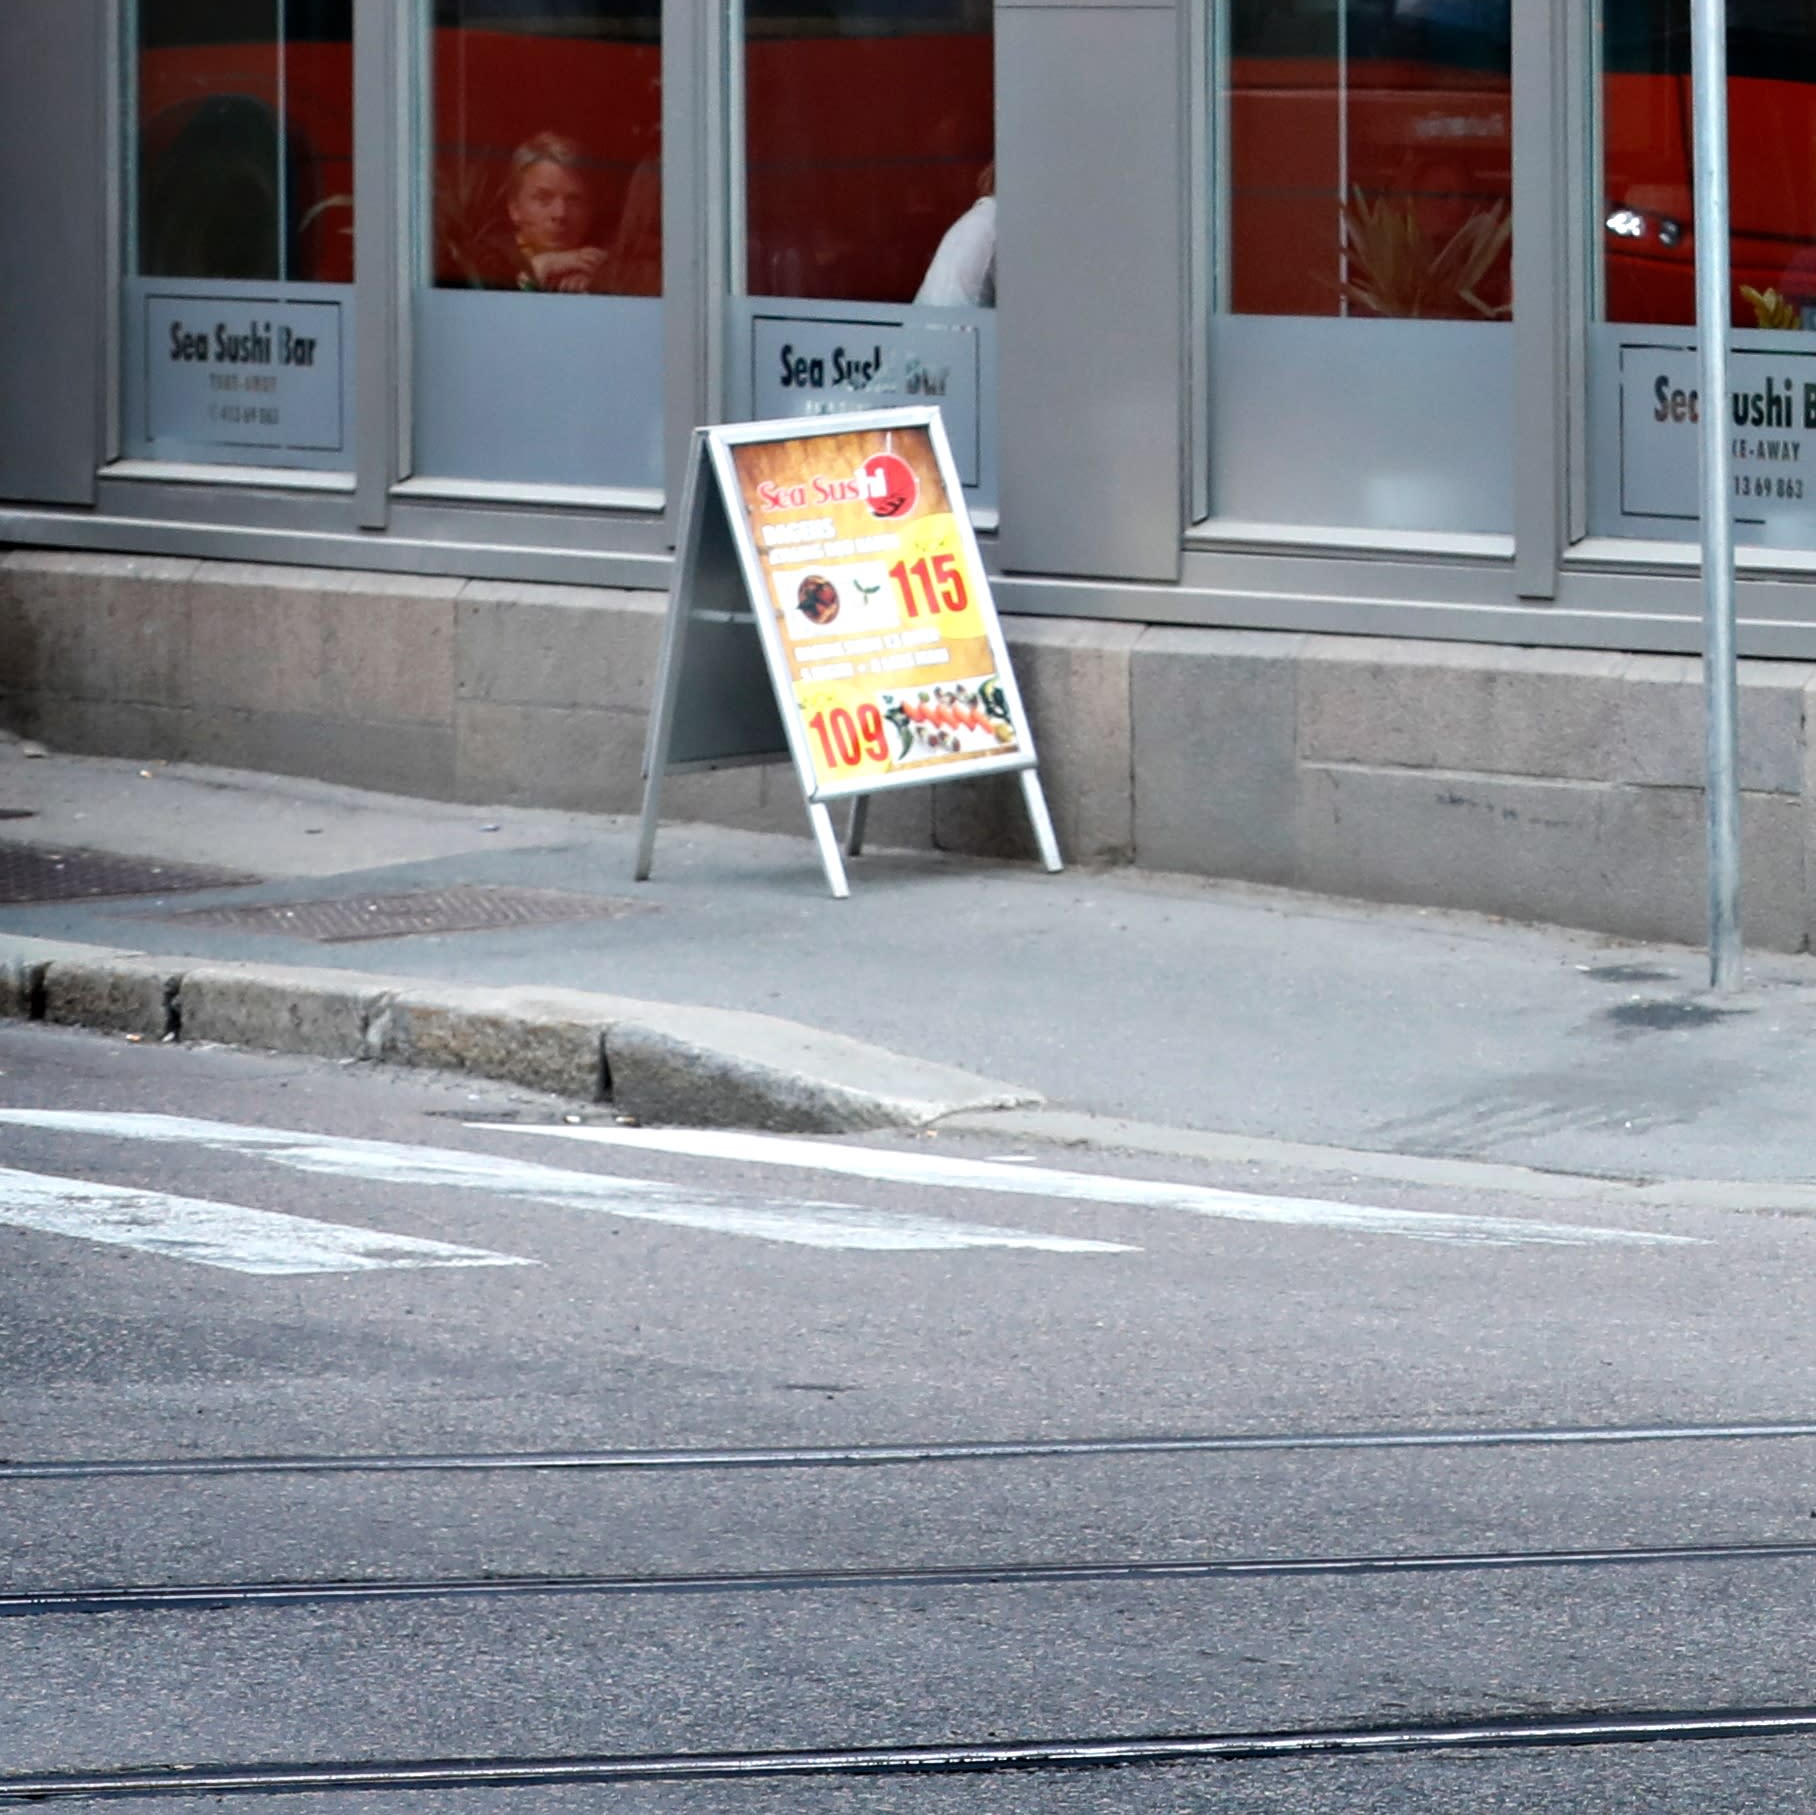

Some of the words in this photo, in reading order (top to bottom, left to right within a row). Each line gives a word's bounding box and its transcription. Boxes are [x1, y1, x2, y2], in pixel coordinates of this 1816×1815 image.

[169, 320, 208, 362] Sea
[214, 320, 271, 365] Sushi
[277, 325, 317, 366] Bar
[780, 344, 824, 388] Sea
[1732, 377, 1793, 430] ushi
[1732, 440, 1801, 462] E-AWAY
[757, 479, 808, 512] Sea
[812, 468, 888, 505] Sushi
[1754, 477, 1772, 497] 69
[1776, 478, 1804, 500] 863
[889, 552, 968, 619] 115
[810, 702, 890, 769] 109
